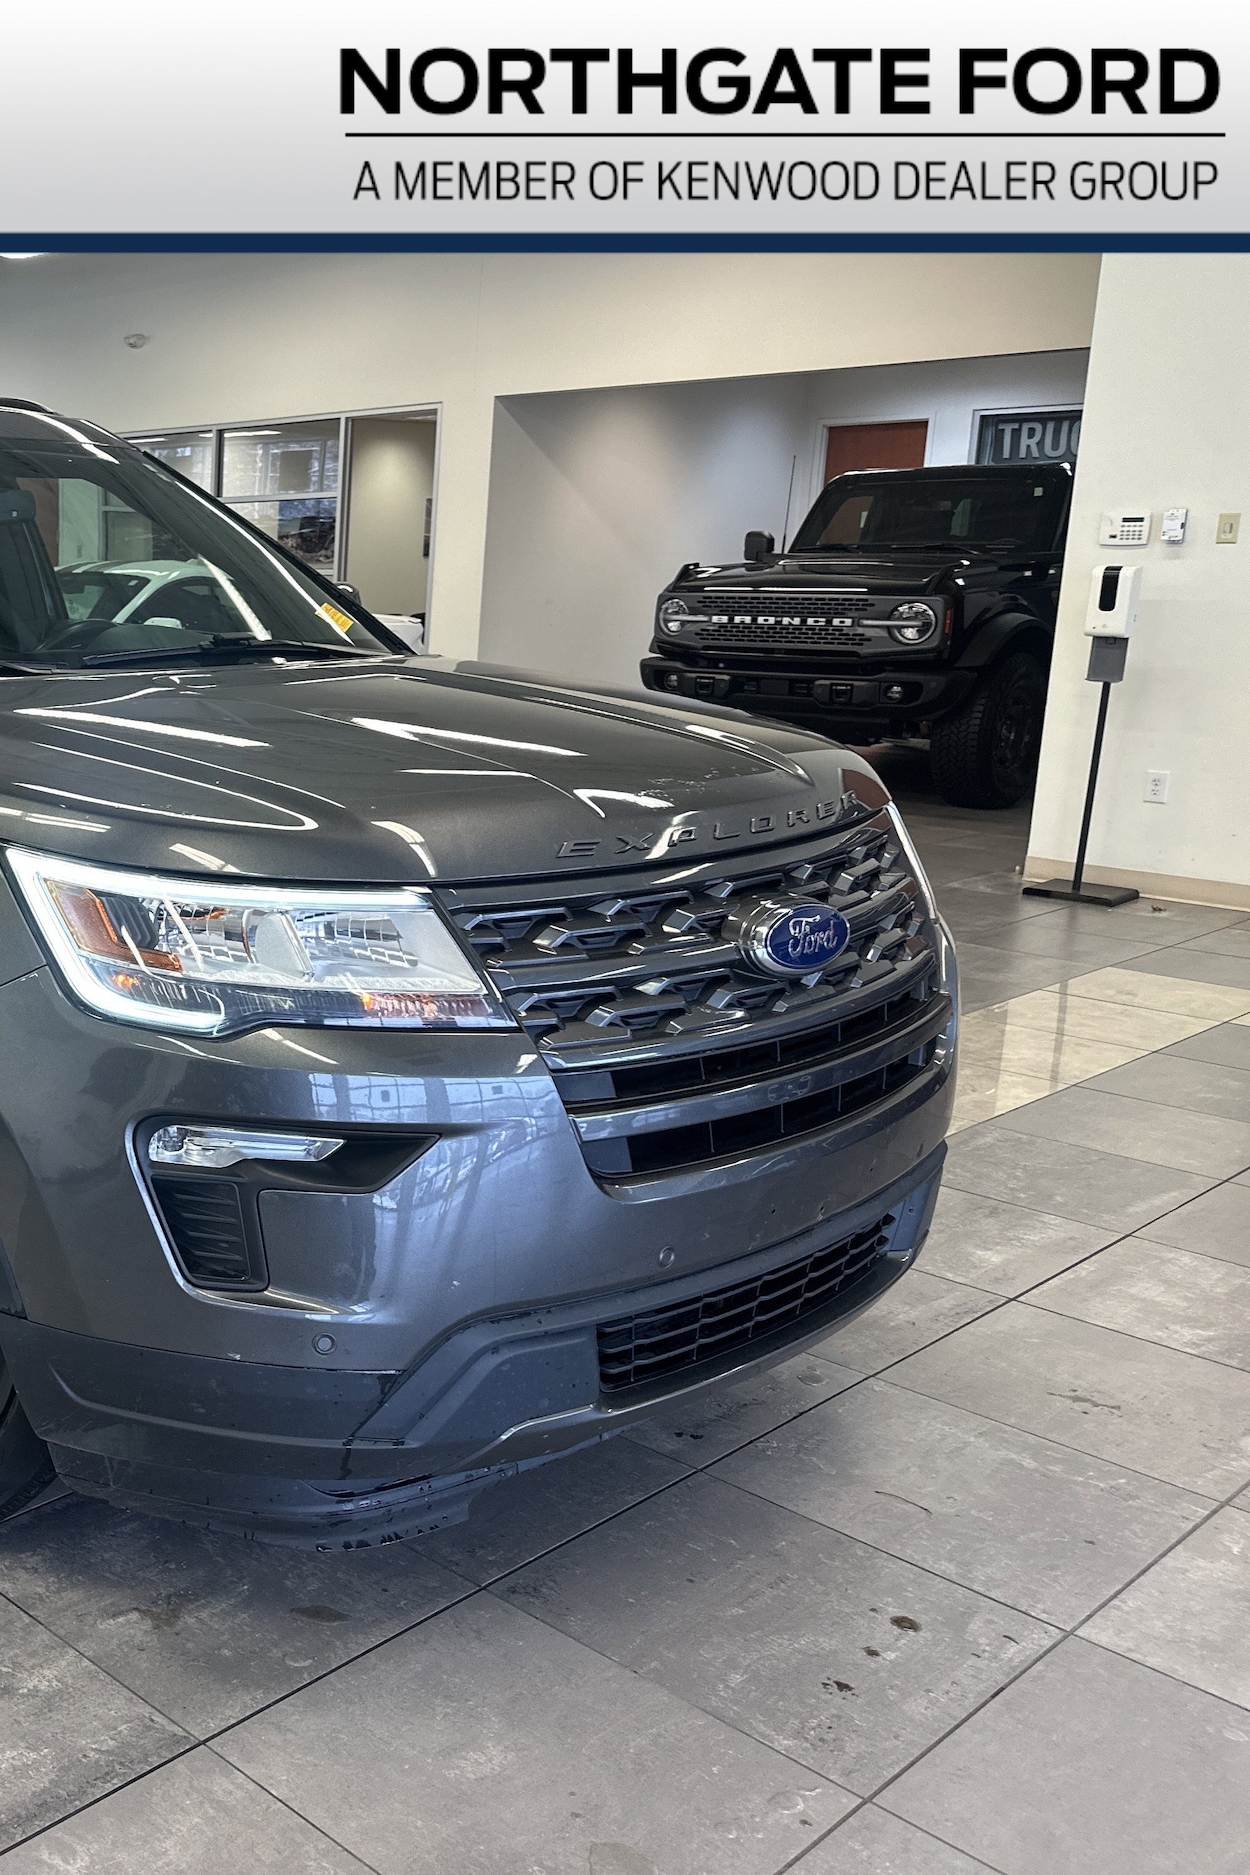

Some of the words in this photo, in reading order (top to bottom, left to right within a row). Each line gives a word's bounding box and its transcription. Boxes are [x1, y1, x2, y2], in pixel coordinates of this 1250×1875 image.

[711, 615, 853, 627] BRONCO
[555, 791, 859, 858] EXPLORER
[788, 914, 838, 958] Ford
